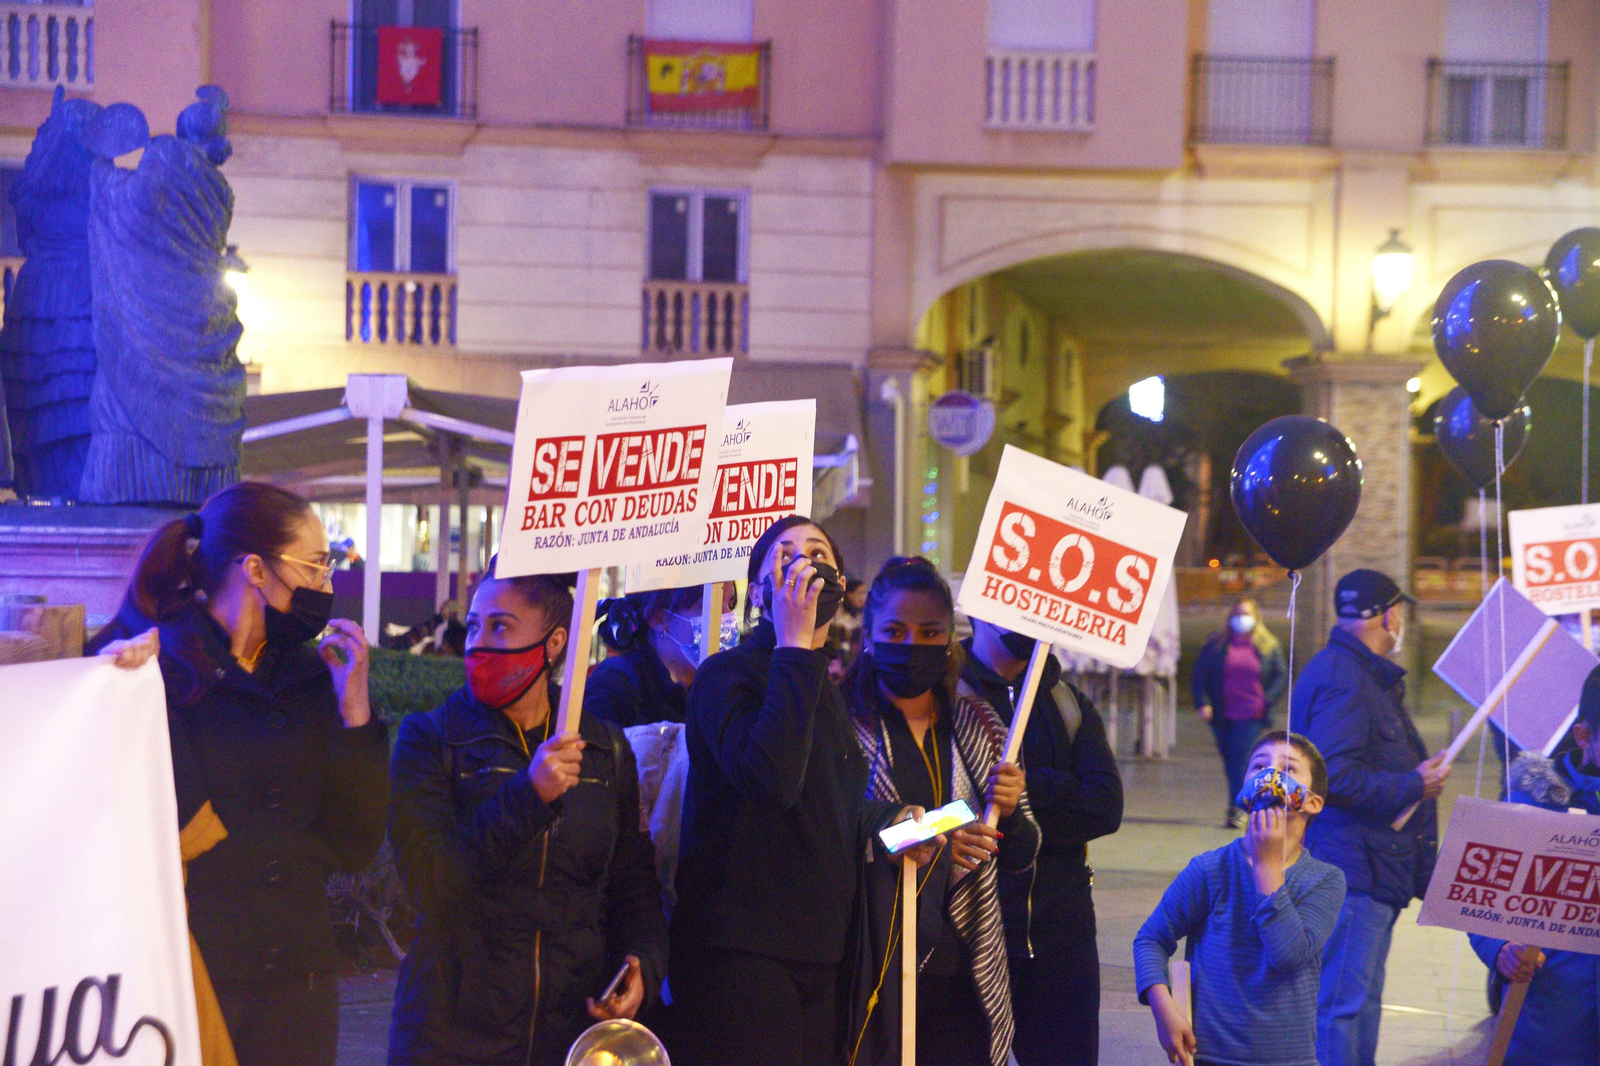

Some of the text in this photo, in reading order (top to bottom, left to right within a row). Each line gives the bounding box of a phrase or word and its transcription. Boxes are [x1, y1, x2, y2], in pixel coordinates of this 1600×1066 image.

[532, 429, 705, 495] SE VENDE
[521, 487, 698, 531] BAR CON DEUDAS
[534, 519, 679, 549] RAZÓN: JUNTA DE ANDALUCÍA
[693, 550, 718, 564] JUNTA
[720, 547, 732, 559] DE
[992, 511, 1150, 614] S.O.S
[981, 575, 1127, 646] HOSTELERIA
[1459, 847, 1520, 888] SE
[1446, 884, 1600, 924] BAR CON DE
[1460, 907, 1504, 923] RAZÓN:
[1506, 916, 1545, 930] JUNTA
[1548, 923, 1566, 933] DE
